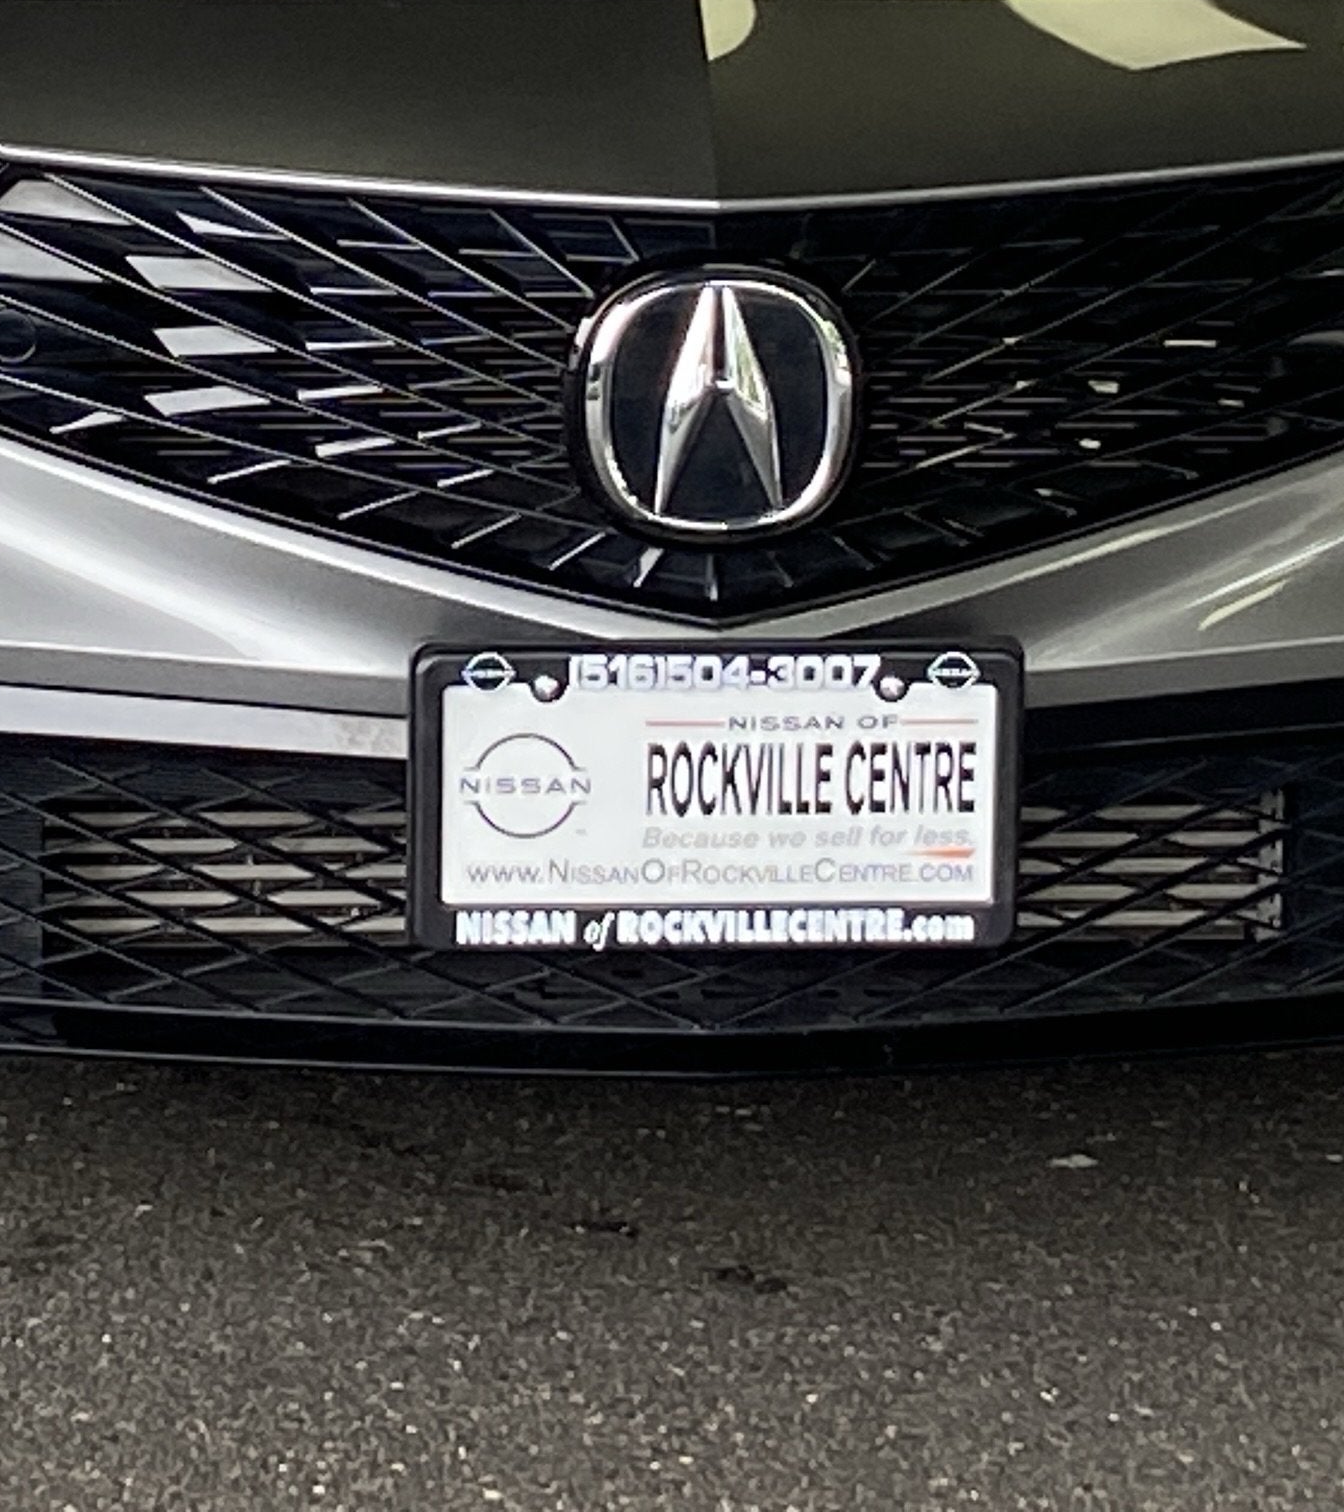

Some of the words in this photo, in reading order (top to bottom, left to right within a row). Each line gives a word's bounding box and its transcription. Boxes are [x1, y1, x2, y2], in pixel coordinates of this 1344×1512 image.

[568, 653, 881, 689] (516)504-3007
[727, 715, 845, 732] NISSAN
[856, 714, 898, 730] OF
[459, 777, 592, 795] NISSAN
[645, 740, 834, 817] ROCKVILLE
[844, 740, 977, 816] CENTRE
[641, 826, 760, 849] Because
[768, 830, 807, 848] we
[814, 825, 863, 848] sell
[869, 824, 908, 847] for
[456, 910, 577, 945] NISSAN
[583, 911, 616, 952] of
